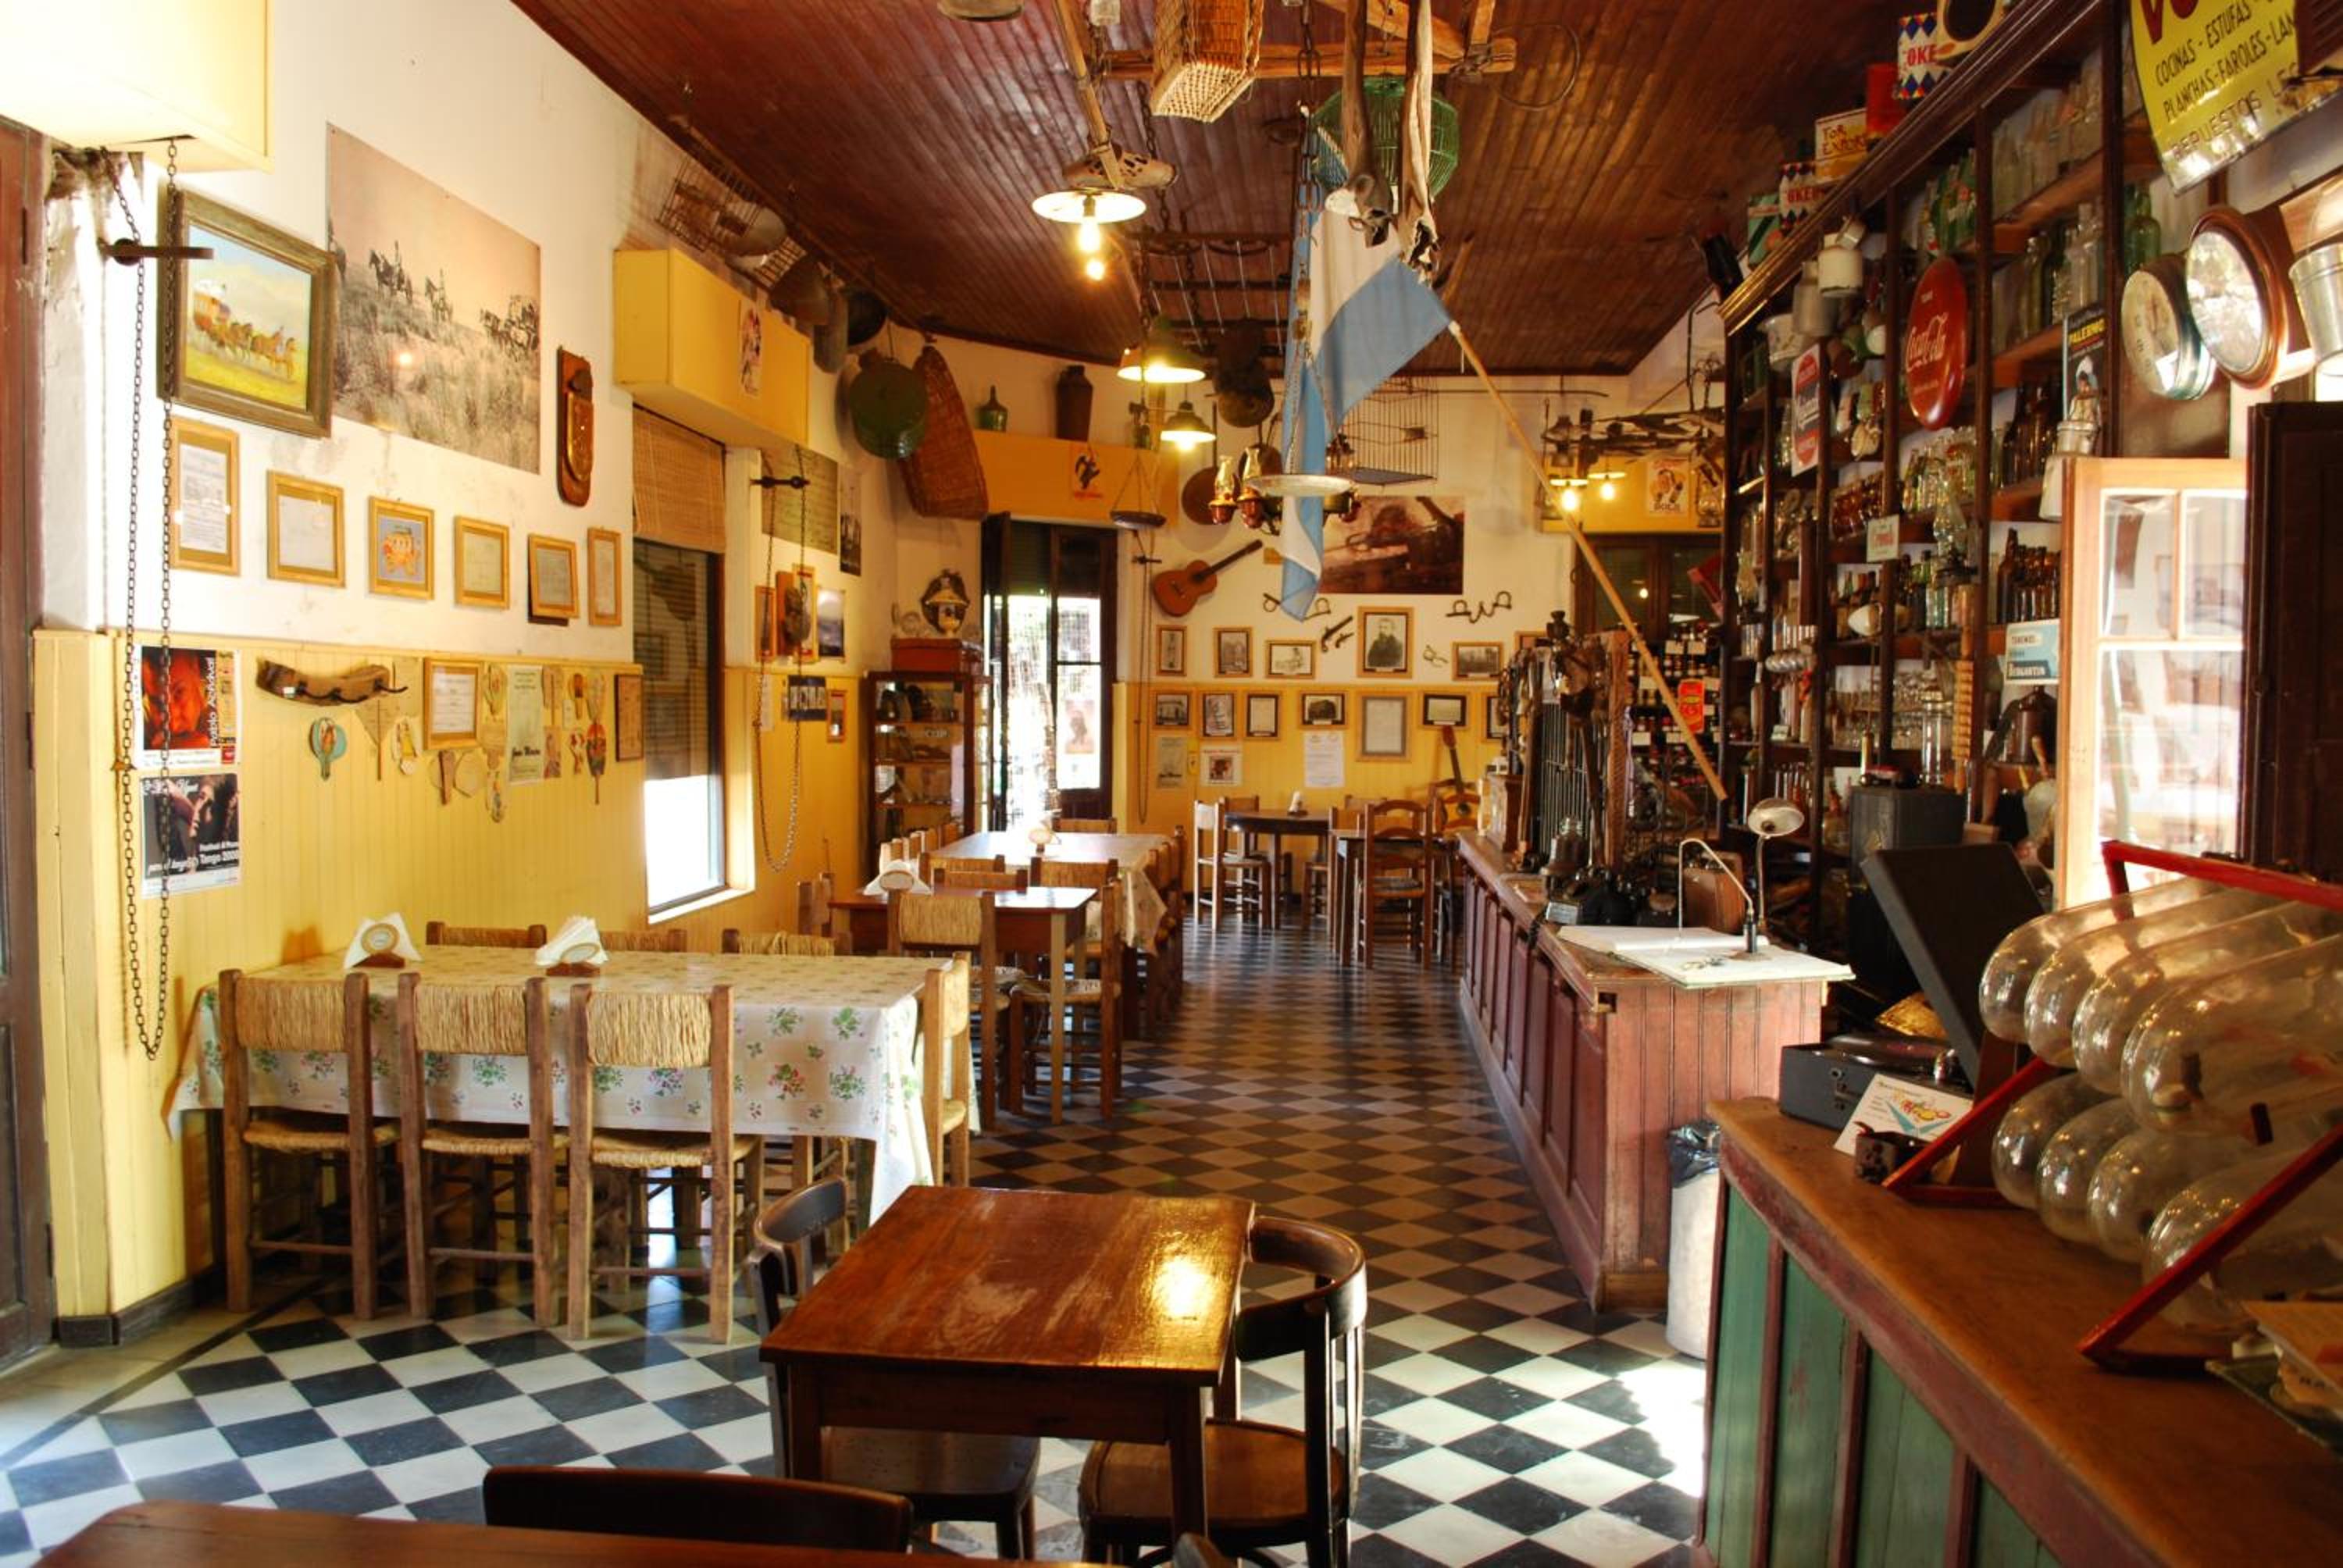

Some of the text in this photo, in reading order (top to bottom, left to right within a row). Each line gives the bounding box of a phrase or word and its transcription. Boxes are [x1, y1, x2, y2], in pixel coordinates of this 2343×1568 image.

[2155, 0, 2252, 87] COCINAS ESTUFAS
[2171, 90, 2262, 159] REPUESTOS
